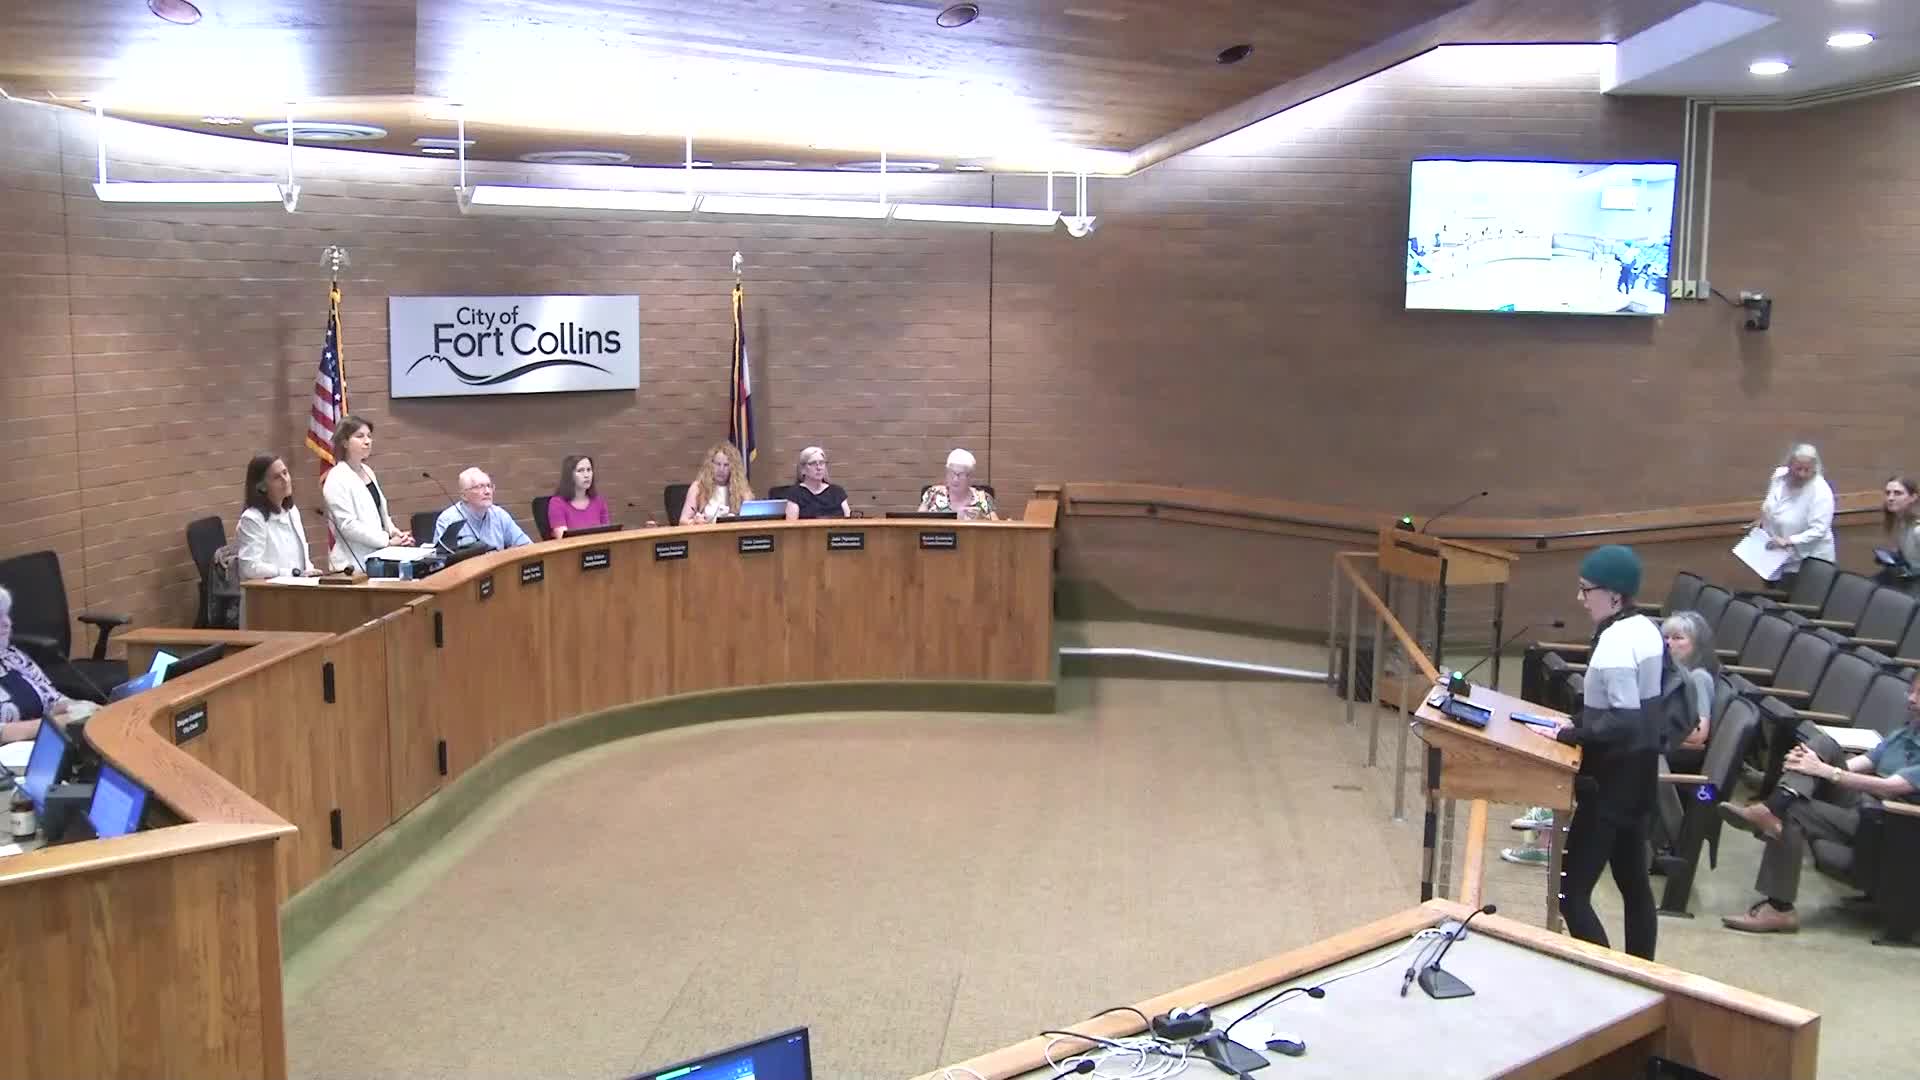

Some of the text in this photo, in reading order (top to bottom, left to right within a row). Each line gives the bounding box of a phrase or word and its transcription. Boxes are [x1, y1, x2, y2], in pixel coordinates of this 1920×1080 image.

[457, 305, 519, 329] City of
[434, 322, 621, 357] Fort Collins
